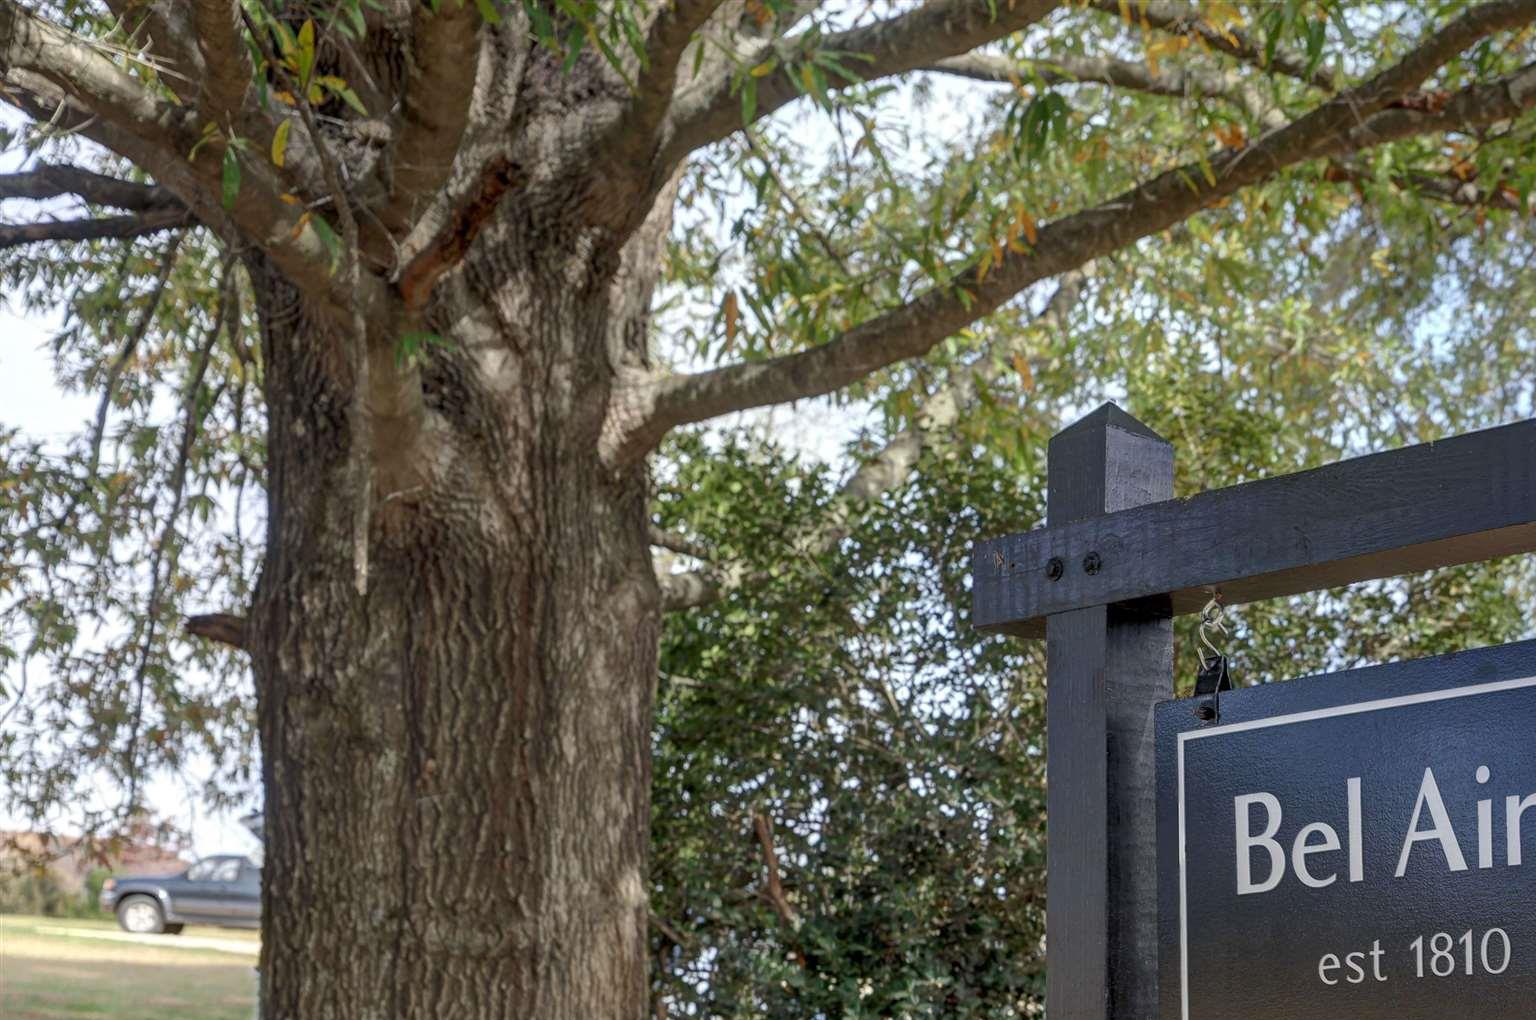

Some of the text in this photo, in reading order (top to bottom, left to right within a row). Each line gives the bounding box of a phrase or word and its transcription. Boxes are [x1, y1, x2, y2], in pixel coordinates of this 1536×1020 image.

[1234, 777, 1364, 895] Bel
[1318, 927, 1511, 985] est 1810
